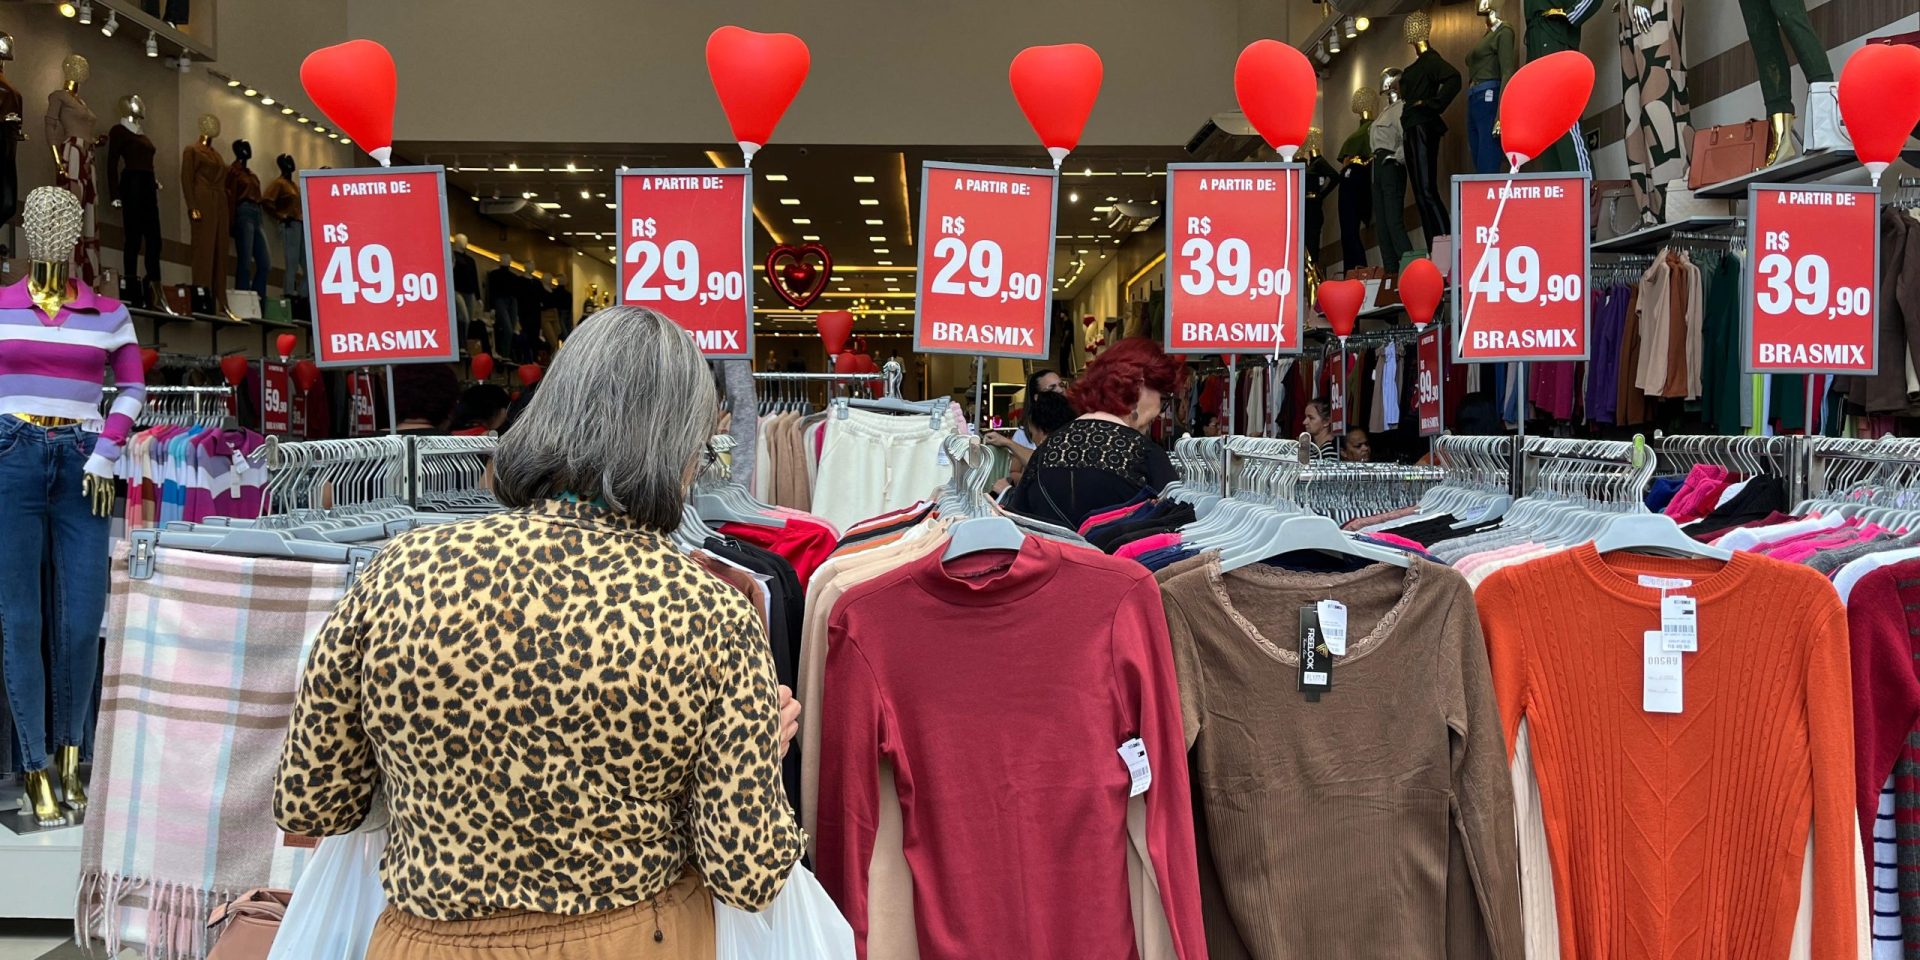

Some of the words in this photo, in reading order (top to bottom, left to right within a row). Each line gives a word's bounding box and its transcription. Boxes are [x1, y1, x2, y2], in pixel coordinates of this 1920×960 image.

[331, 183, 340, 197] A
[343, 182, 387, 196] PARTIR
[390, 180, 411, 194] DE:
[642, 177, 651, 190] A
[655, 176, 699, 190] PARTIR
[703, 176, 724, 190] DE:
[954, 177, 963, 191] A
[966, 178, 1008, 194] PARTIR
[1011, 182, 1033, 195] DE:
[1199, 178, 1208, 191] A
[1211, 178, 1253, 192] PARTIR
[1257, 178, 1276, 192] DE:
[1487, 188, 1495, 200] A
[1544, 186, 1564, 199] DE:
[1778, 191, 1787, 204] A
[1790, 192, 1832, 206] PARTIR
[1836, 192, 1856, 206] DE:
[323, 223, 349, 244] R$
[632, 217, 656, 239] R$
[942, 216, 965, 237] R$
[1187, 216, 1212, 236] R$
[1476, 226, 1499, 245] R$
[1765, 230, 1789, 252] R$
[321, 244, 438, 307] 49,90
[625, 239, 743, 305] 29,90
[931, 237, 1042, 304] 29,90
[1180, 237, 1291, 300] 39,90
[1468, 245, 1581, 307] 49,90
[1757, 254, 1871, 321] 39,90
[330, 329, 439, 353] BRASMIX
[932, 322, 1035, 348] BRASMIX
[1181, 322, 1286, 342] BRASMIX
[1473, 328, 1577, 349] BRASMIX
[1760, 343, 1866, 364] BRASMIX
